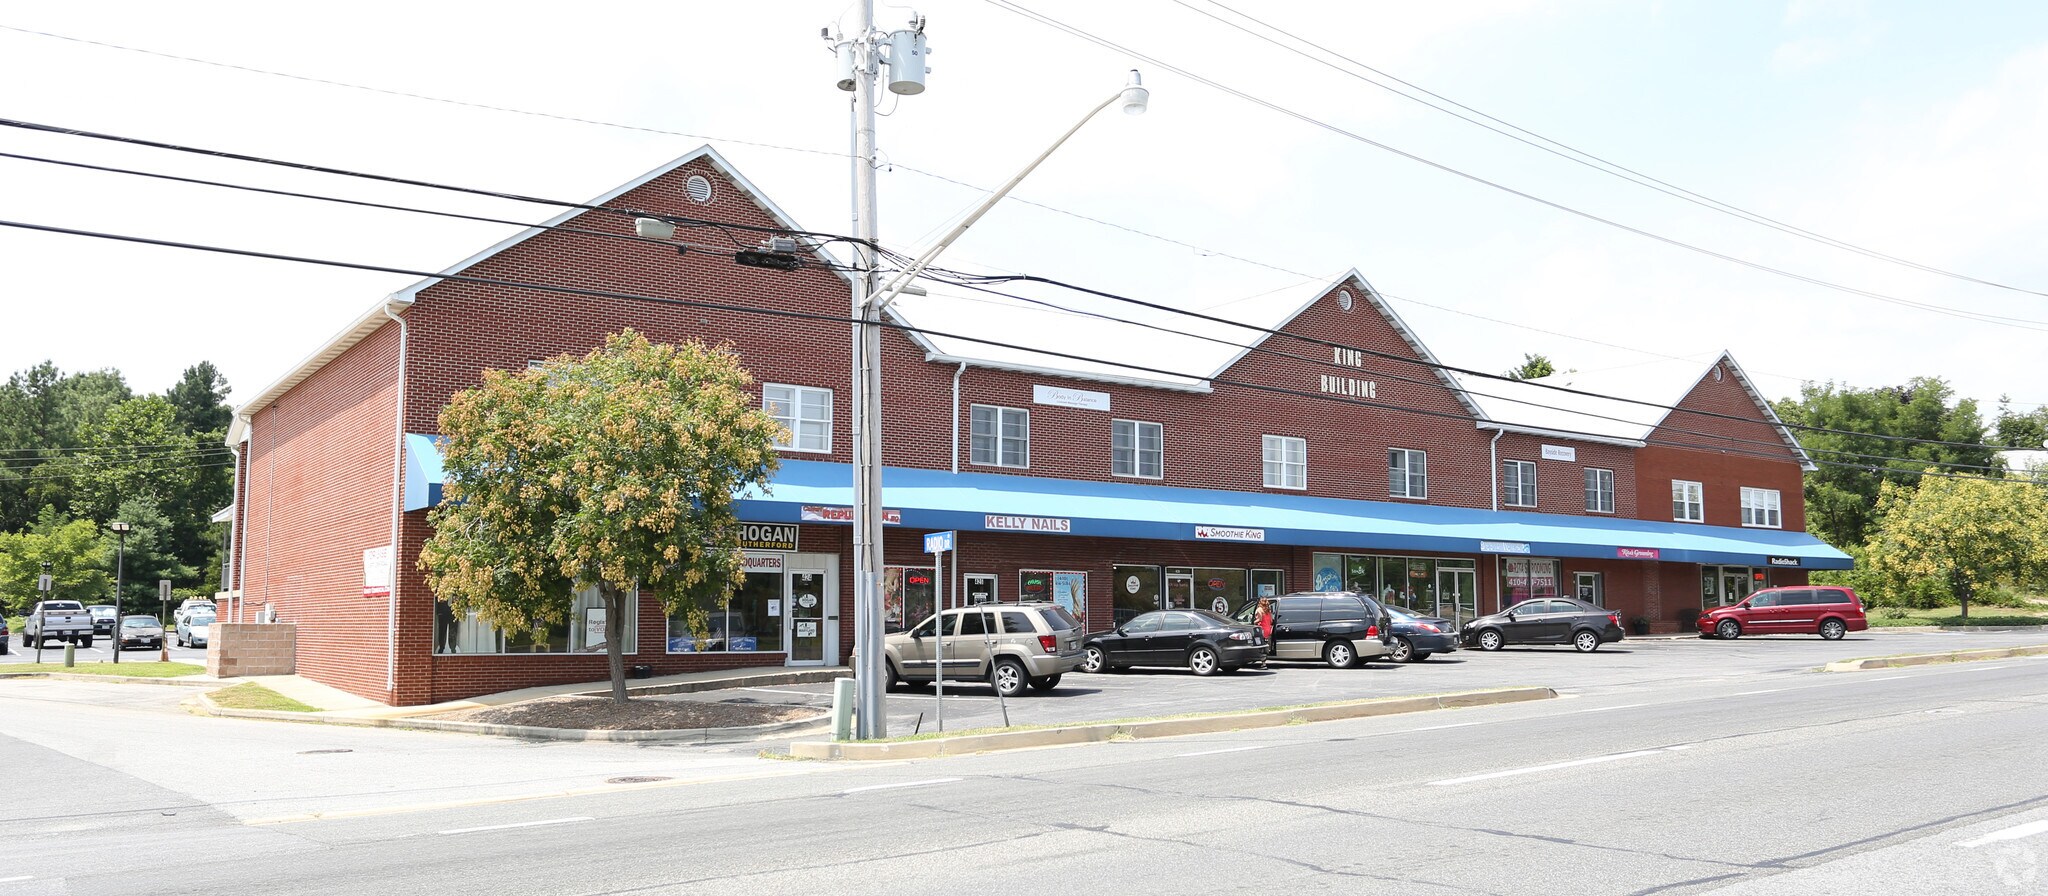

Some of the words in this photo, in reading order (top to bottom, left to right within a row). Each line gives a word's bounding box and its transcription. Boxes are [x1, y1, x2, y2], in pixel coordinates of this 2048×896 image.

[1334, 347, 1361, 367] KING
[1321, 374, 1376, 398] BUILDING
[987, 516, 1026, 529] KELLY
[1032, 518, 1068, 531] NAILS
[926, 535, 943, 551] RADIO
[1771, 558, 1798, 566] RadioShack
[909, 576, 929, 584] OPEN
[1208, 579, 1225, 588] OPEN
[1509, 578, 1552, 586] 410-4-7511
